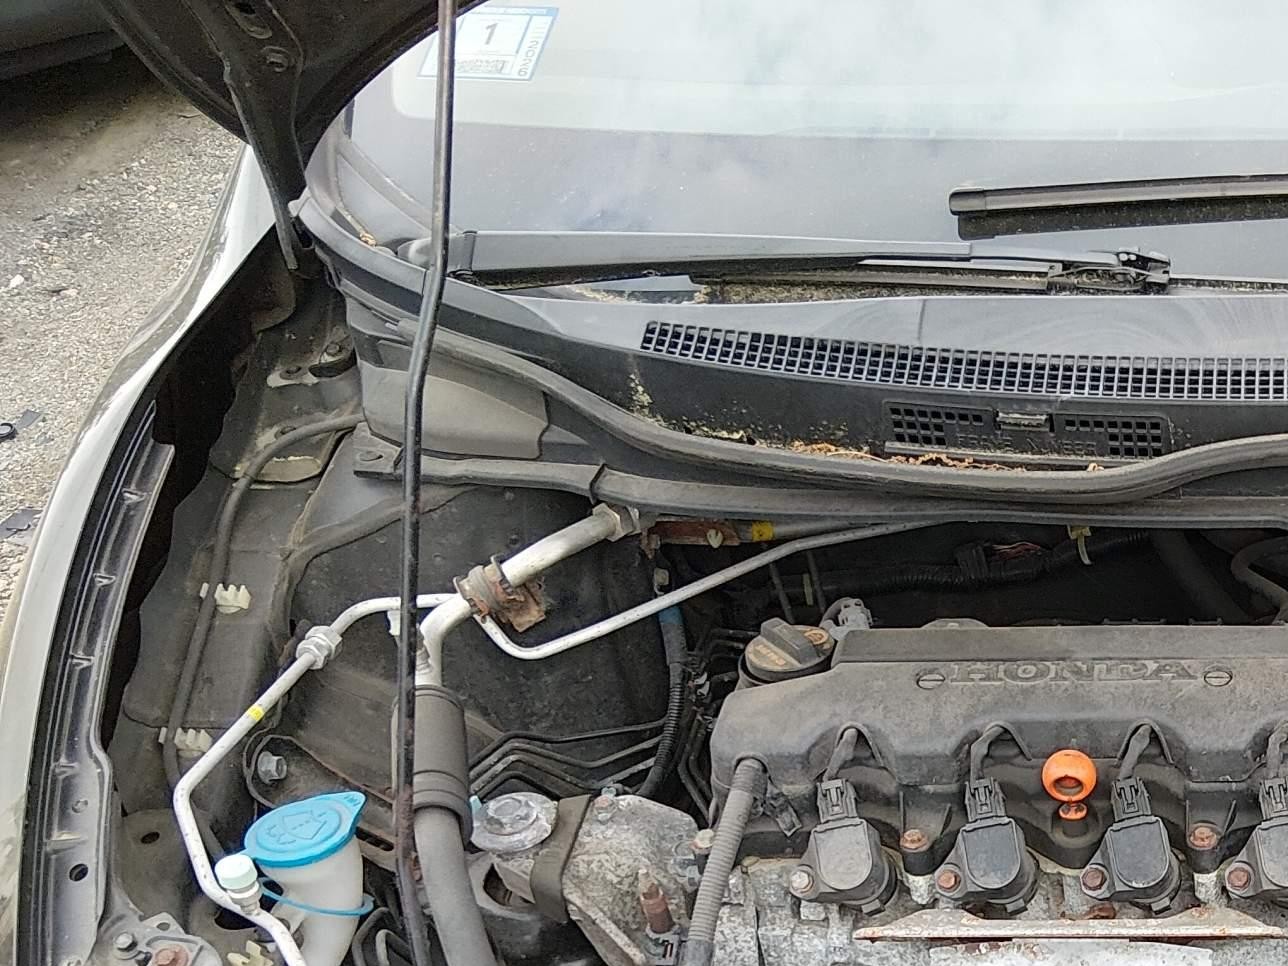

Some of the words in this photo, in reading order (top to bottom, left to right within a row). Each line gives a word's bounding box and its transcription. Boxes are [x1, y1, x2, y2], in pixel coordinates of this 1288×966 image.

[484, 22, 499, 45] 1
[518, 40, 539, 77] 2026
[950, 661, 1199, 683] HONDA
